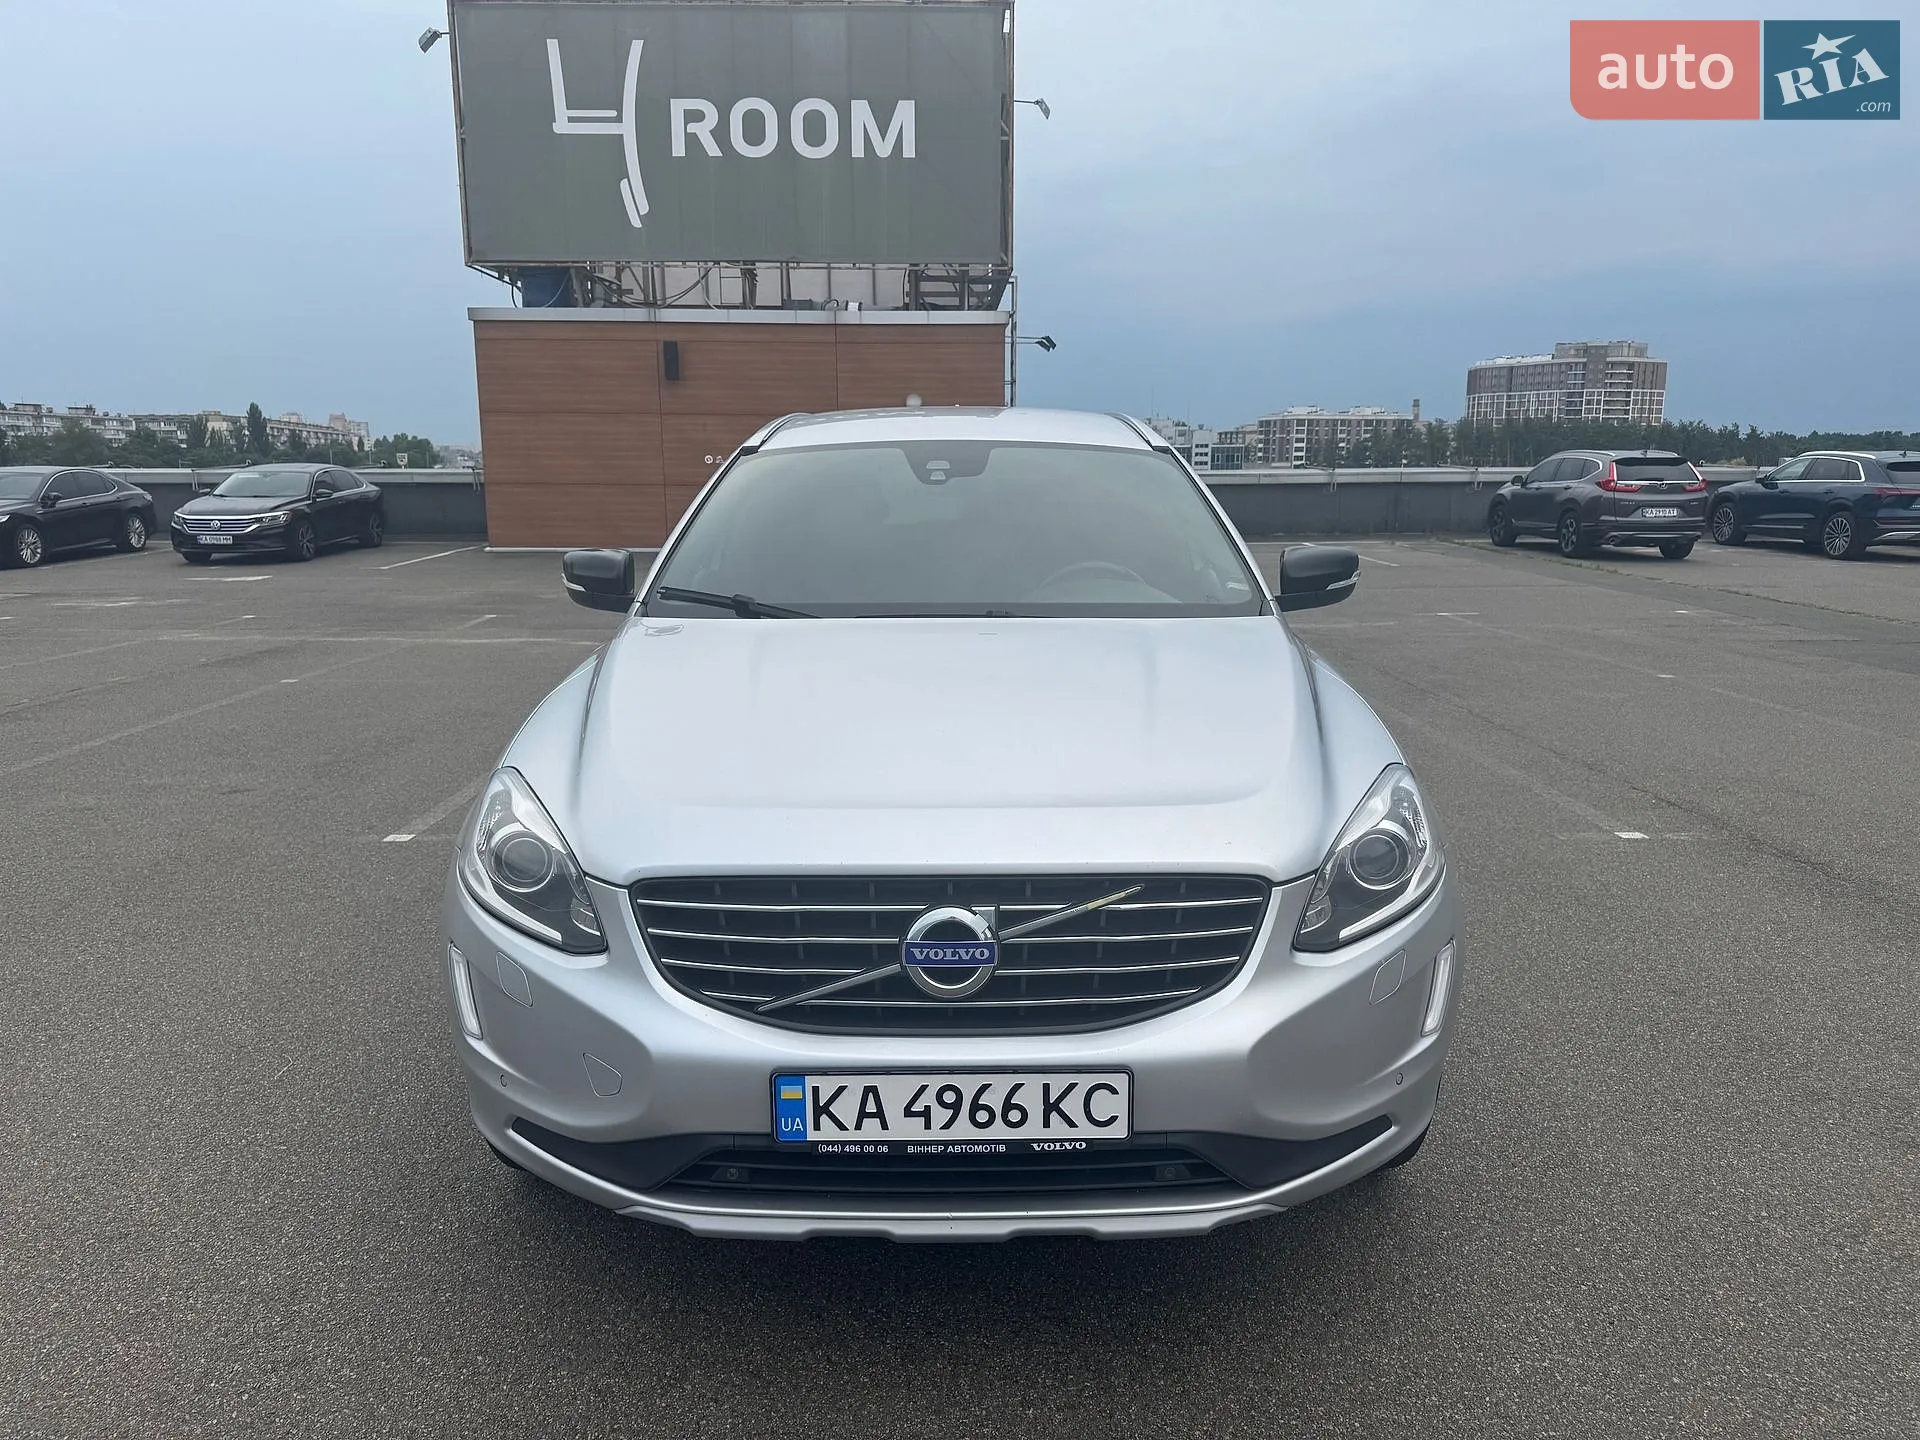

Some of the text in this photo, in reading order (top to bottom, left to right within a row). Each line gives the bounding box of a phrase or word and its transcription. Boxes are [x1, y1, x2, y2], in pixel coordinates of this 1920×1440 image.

[670, 96, 916, 159] ROOM
[910, 948, 990, 960] VOLVO
[781, 1082, 1120, 1132] UA KA 4966 KC
[818, 1140, 1087, 1154] (044) 496 00 06 ВІННЕР АВТОМОТІВ VOLVO
